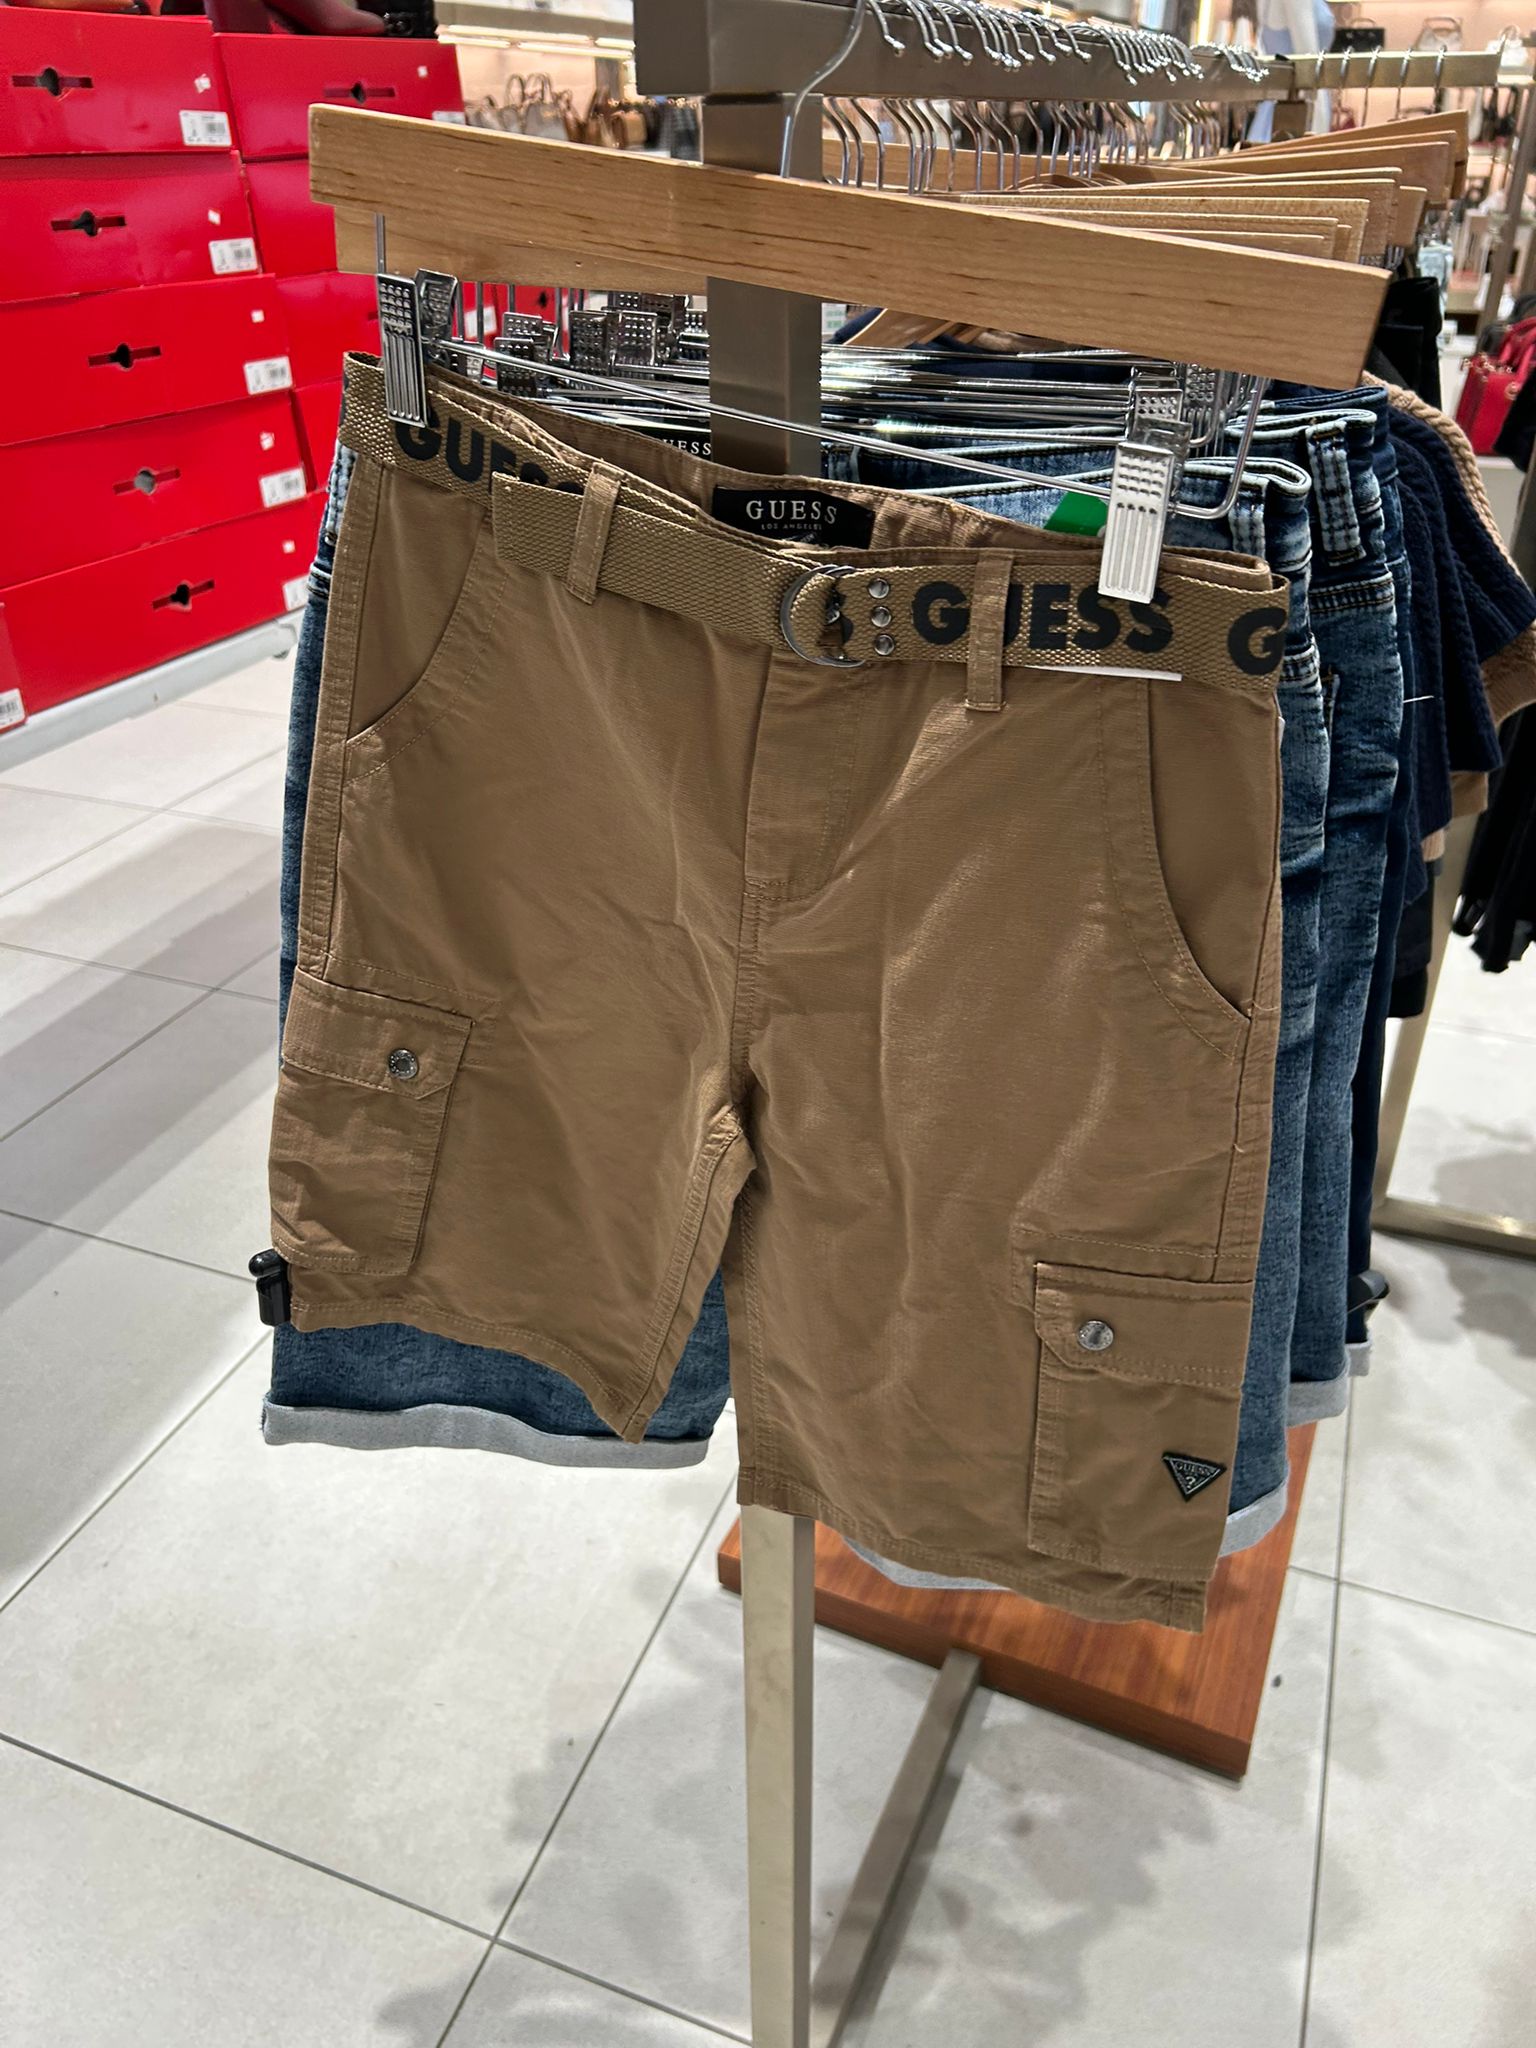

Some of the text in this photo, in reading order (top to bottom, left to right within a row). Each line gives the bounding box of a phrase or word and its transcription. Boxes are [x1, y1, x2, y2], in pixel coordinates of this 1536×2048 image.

[395, 404, 585, 494] GUE
[745, 500, 837, 524] GUESS
[761, 522, 778, 530] LOS
